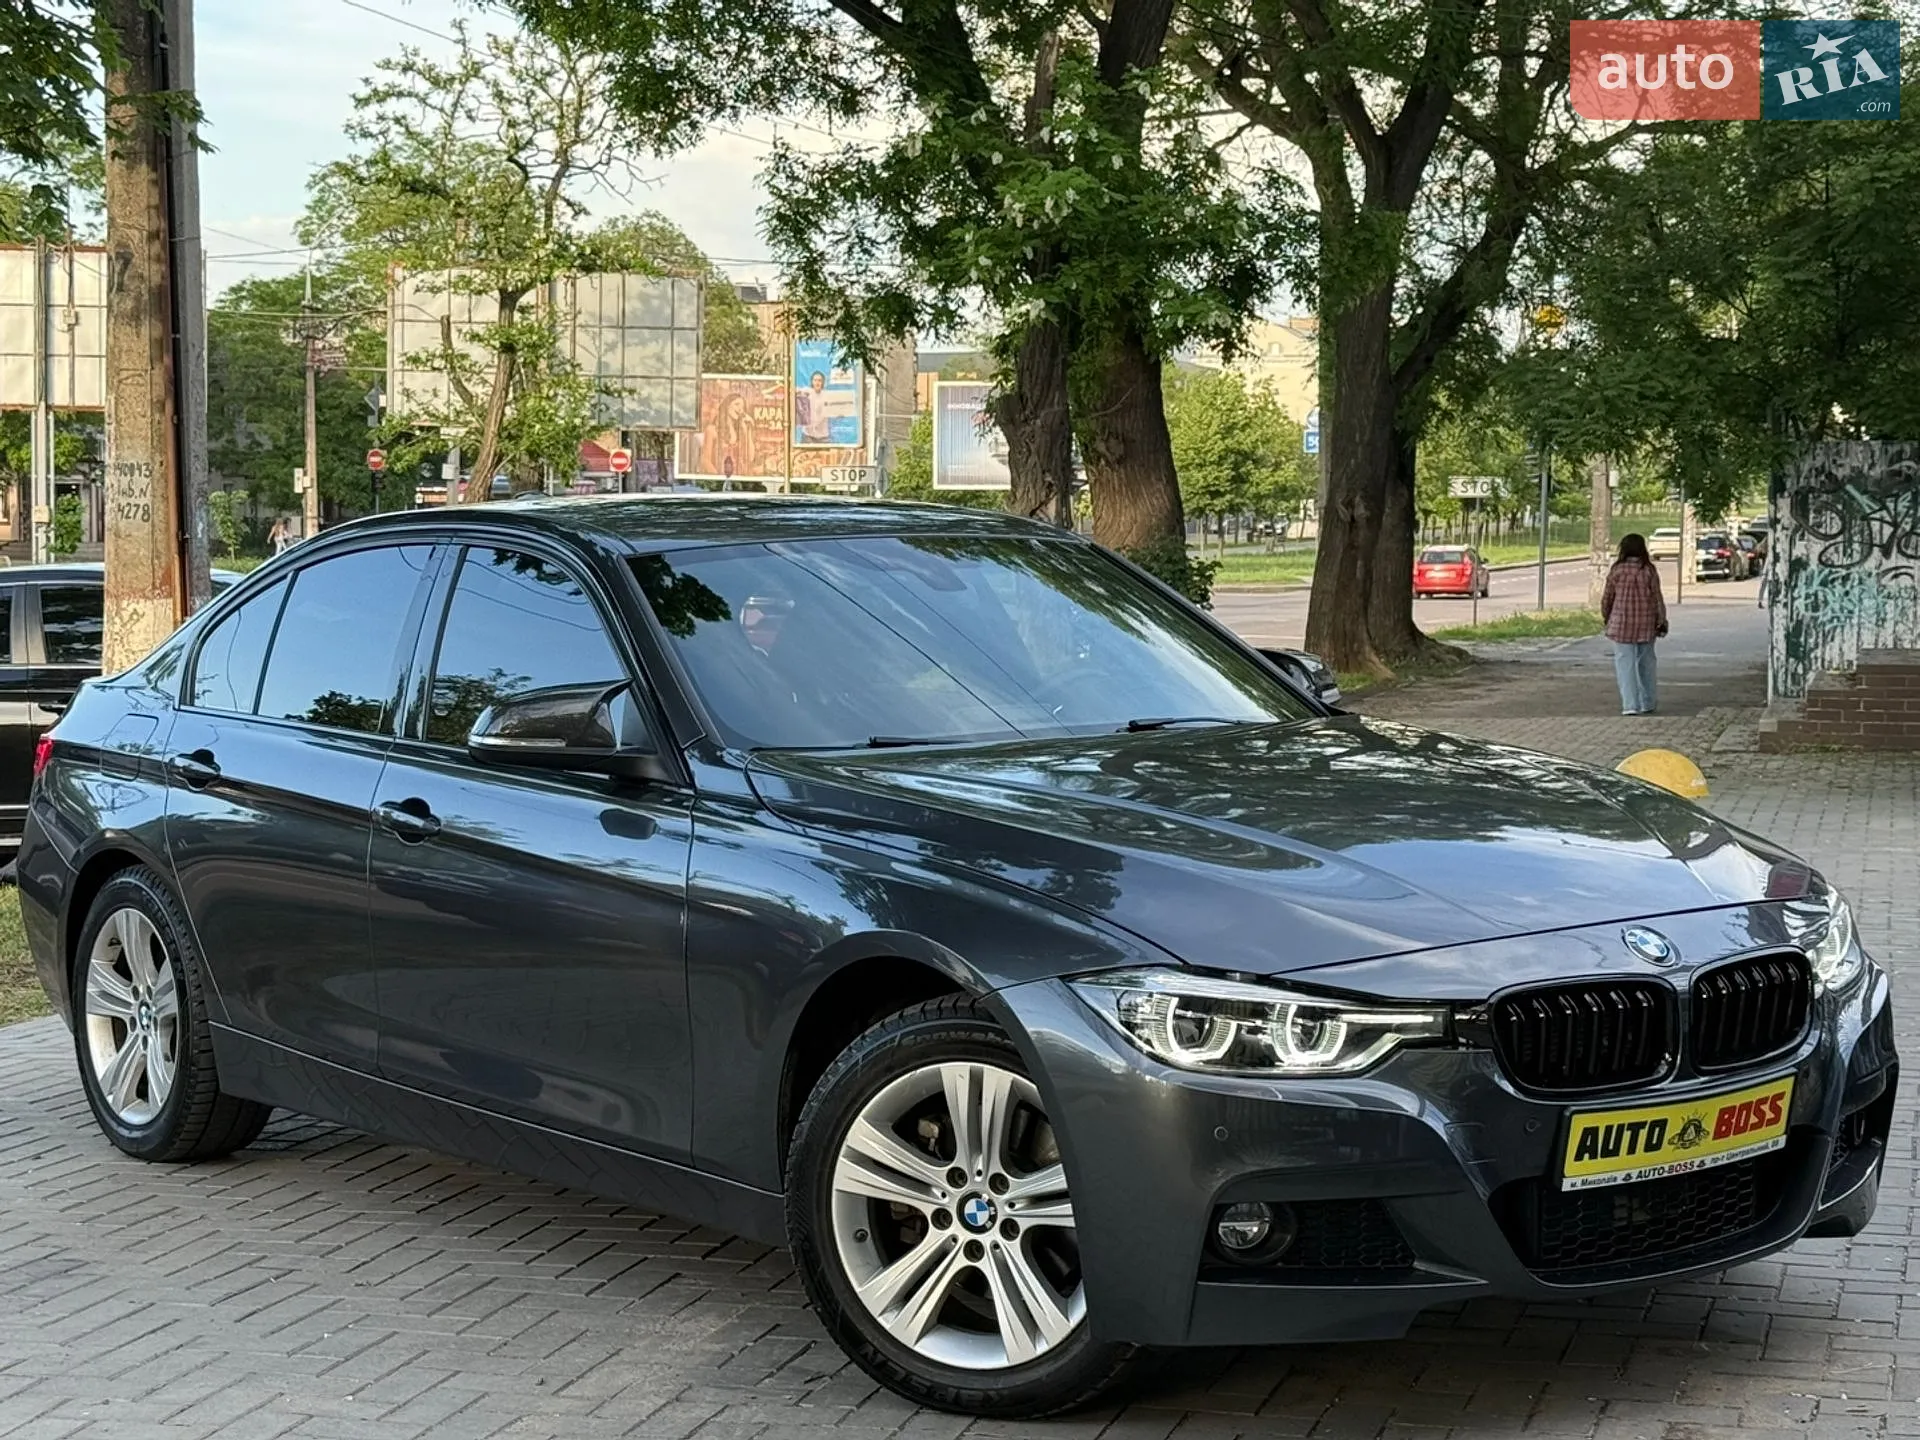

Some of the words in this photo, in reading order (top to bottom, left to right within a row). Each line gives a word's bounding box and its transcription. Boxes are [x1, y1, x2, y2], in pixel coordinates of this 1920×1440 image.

[830, 469, 867, 481] STOP
[117, 502, 151, 523] 4278
[1575, 1118, 1669, 1162] AUTO
[1712, 1092, 1787, 1141] BOSS
[1636, 1161, 1695, 1179] AUTO-BOSS
